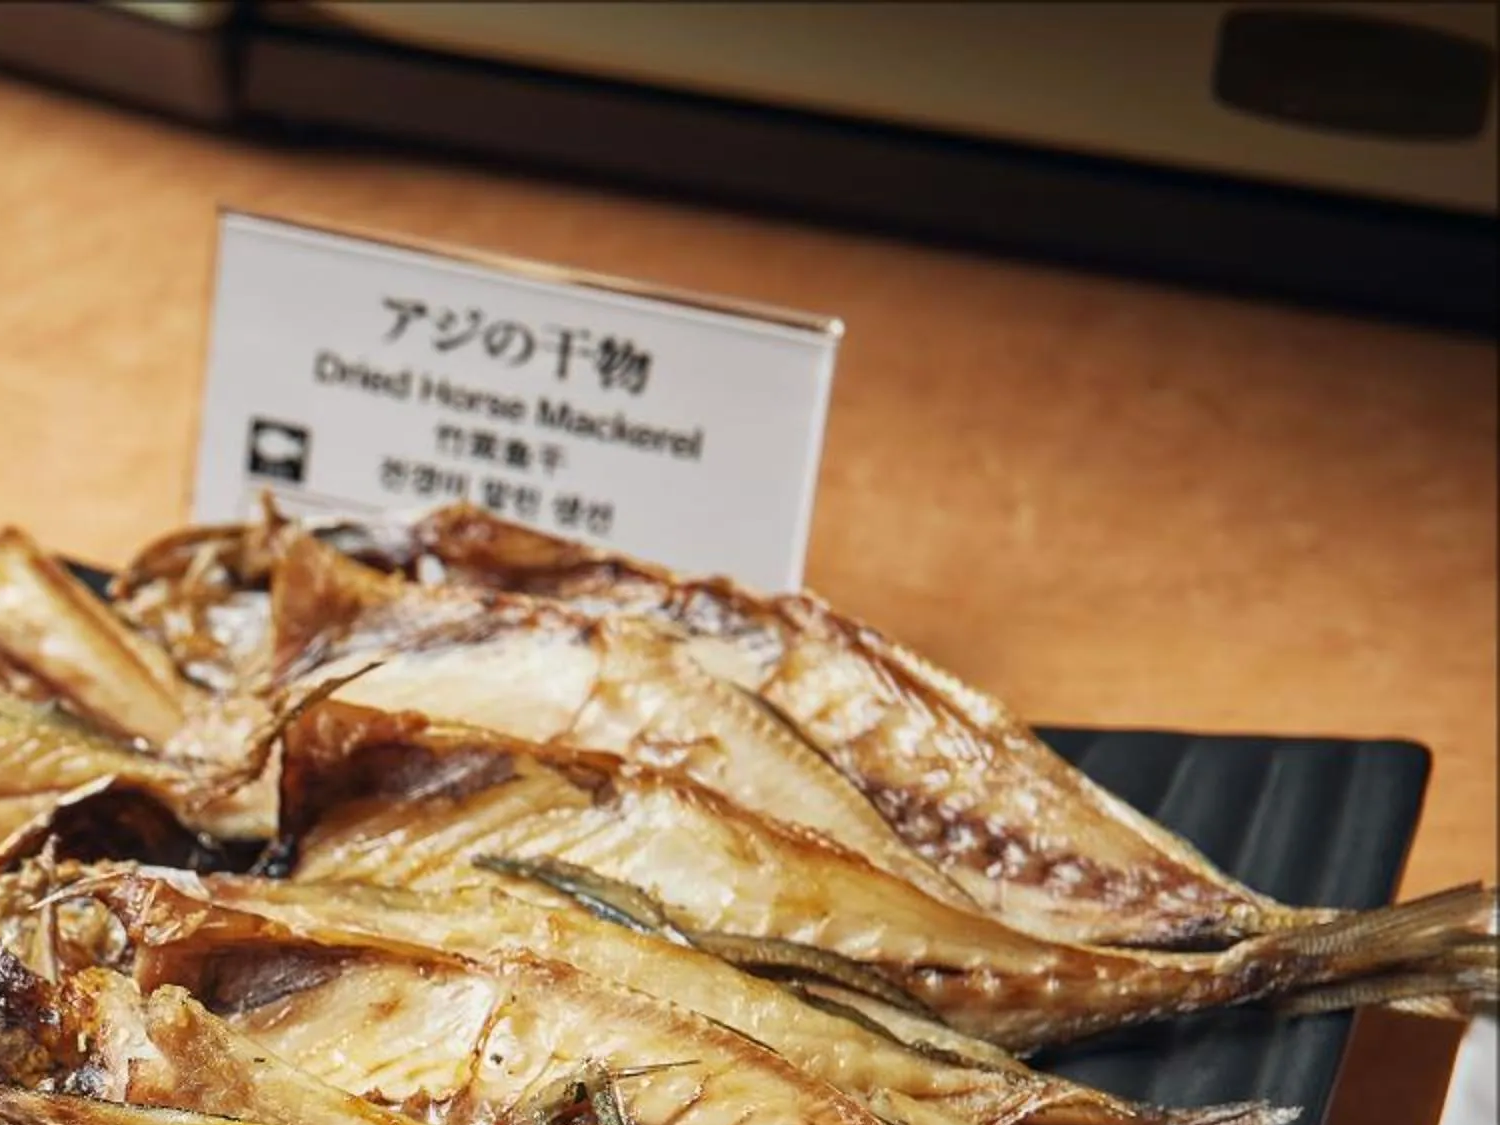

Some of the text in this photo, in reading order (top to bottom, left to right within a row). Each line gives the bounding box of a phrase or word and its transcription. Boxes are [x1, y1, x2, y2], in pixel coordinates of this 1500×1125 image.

[383, 297, 654, 395] アジの干物
[313, 349, 705, 460] Dried Horse Mackerel
